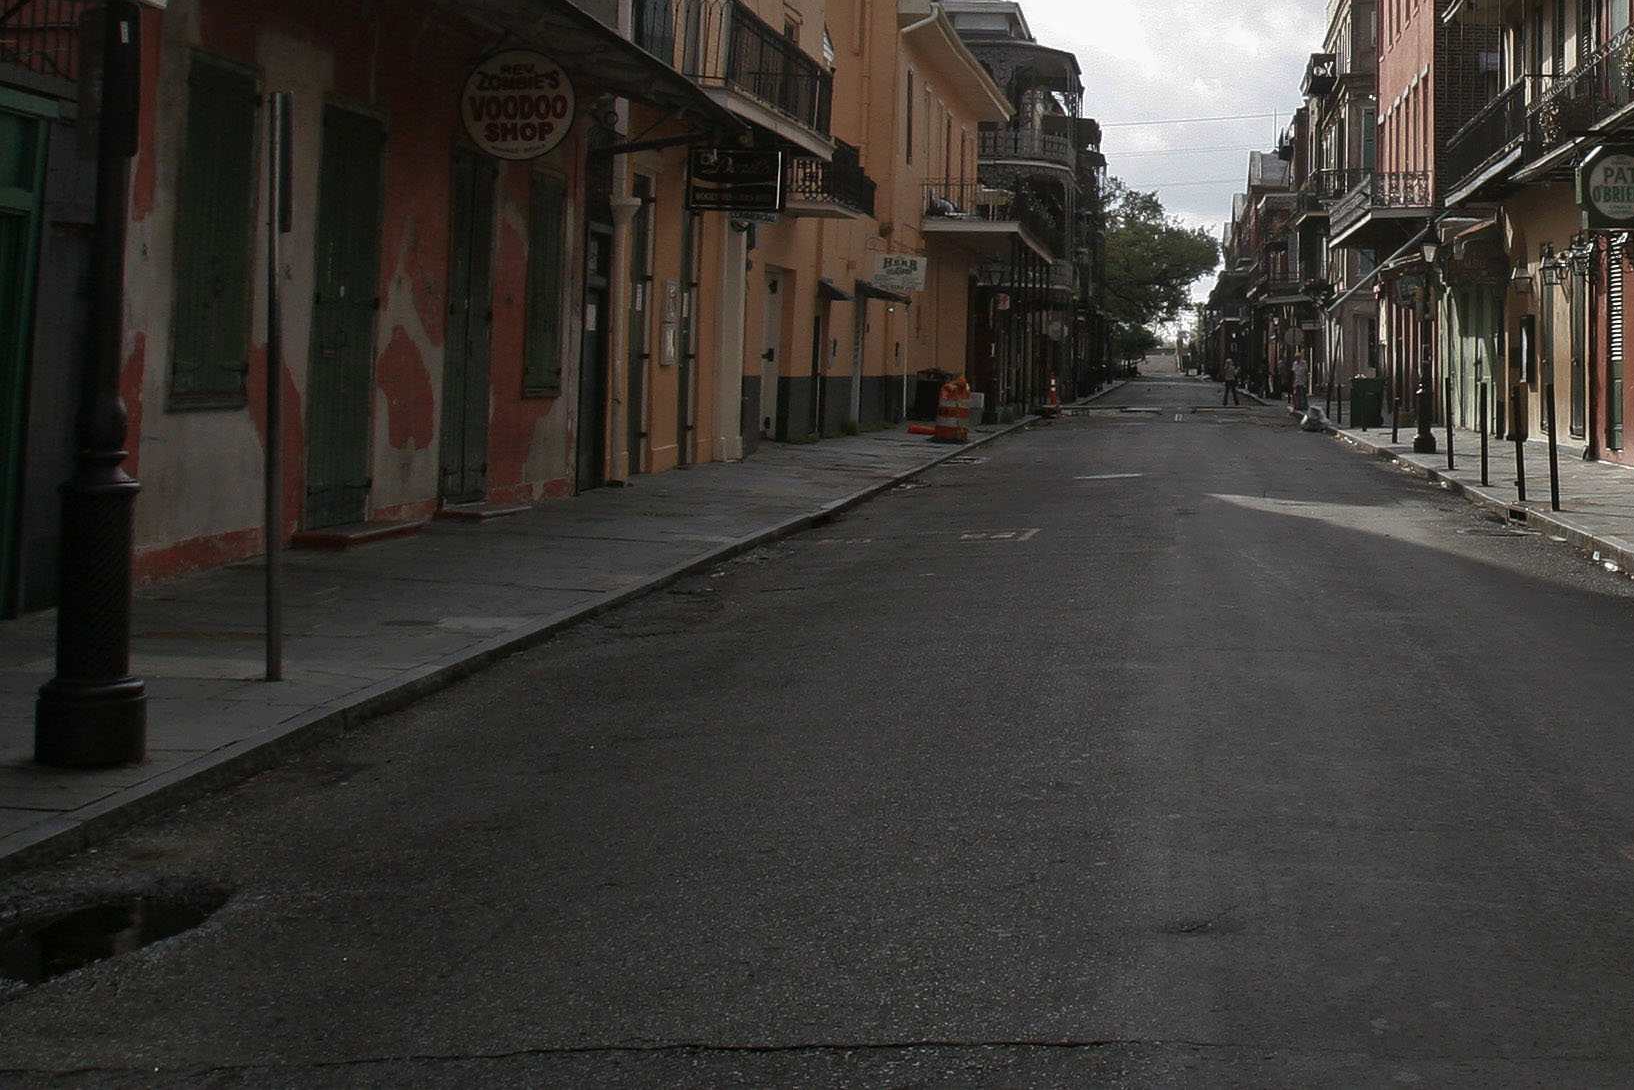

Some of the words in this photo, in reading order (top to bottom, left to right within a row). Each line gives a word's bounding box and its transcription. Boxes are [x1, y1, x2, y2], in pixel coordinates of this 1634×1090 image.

[476, 69, 560, 91] ZOMBIE'S
[468, 94, 568, 122] VOODOO
[484, 122, 554, 143] SHOP
